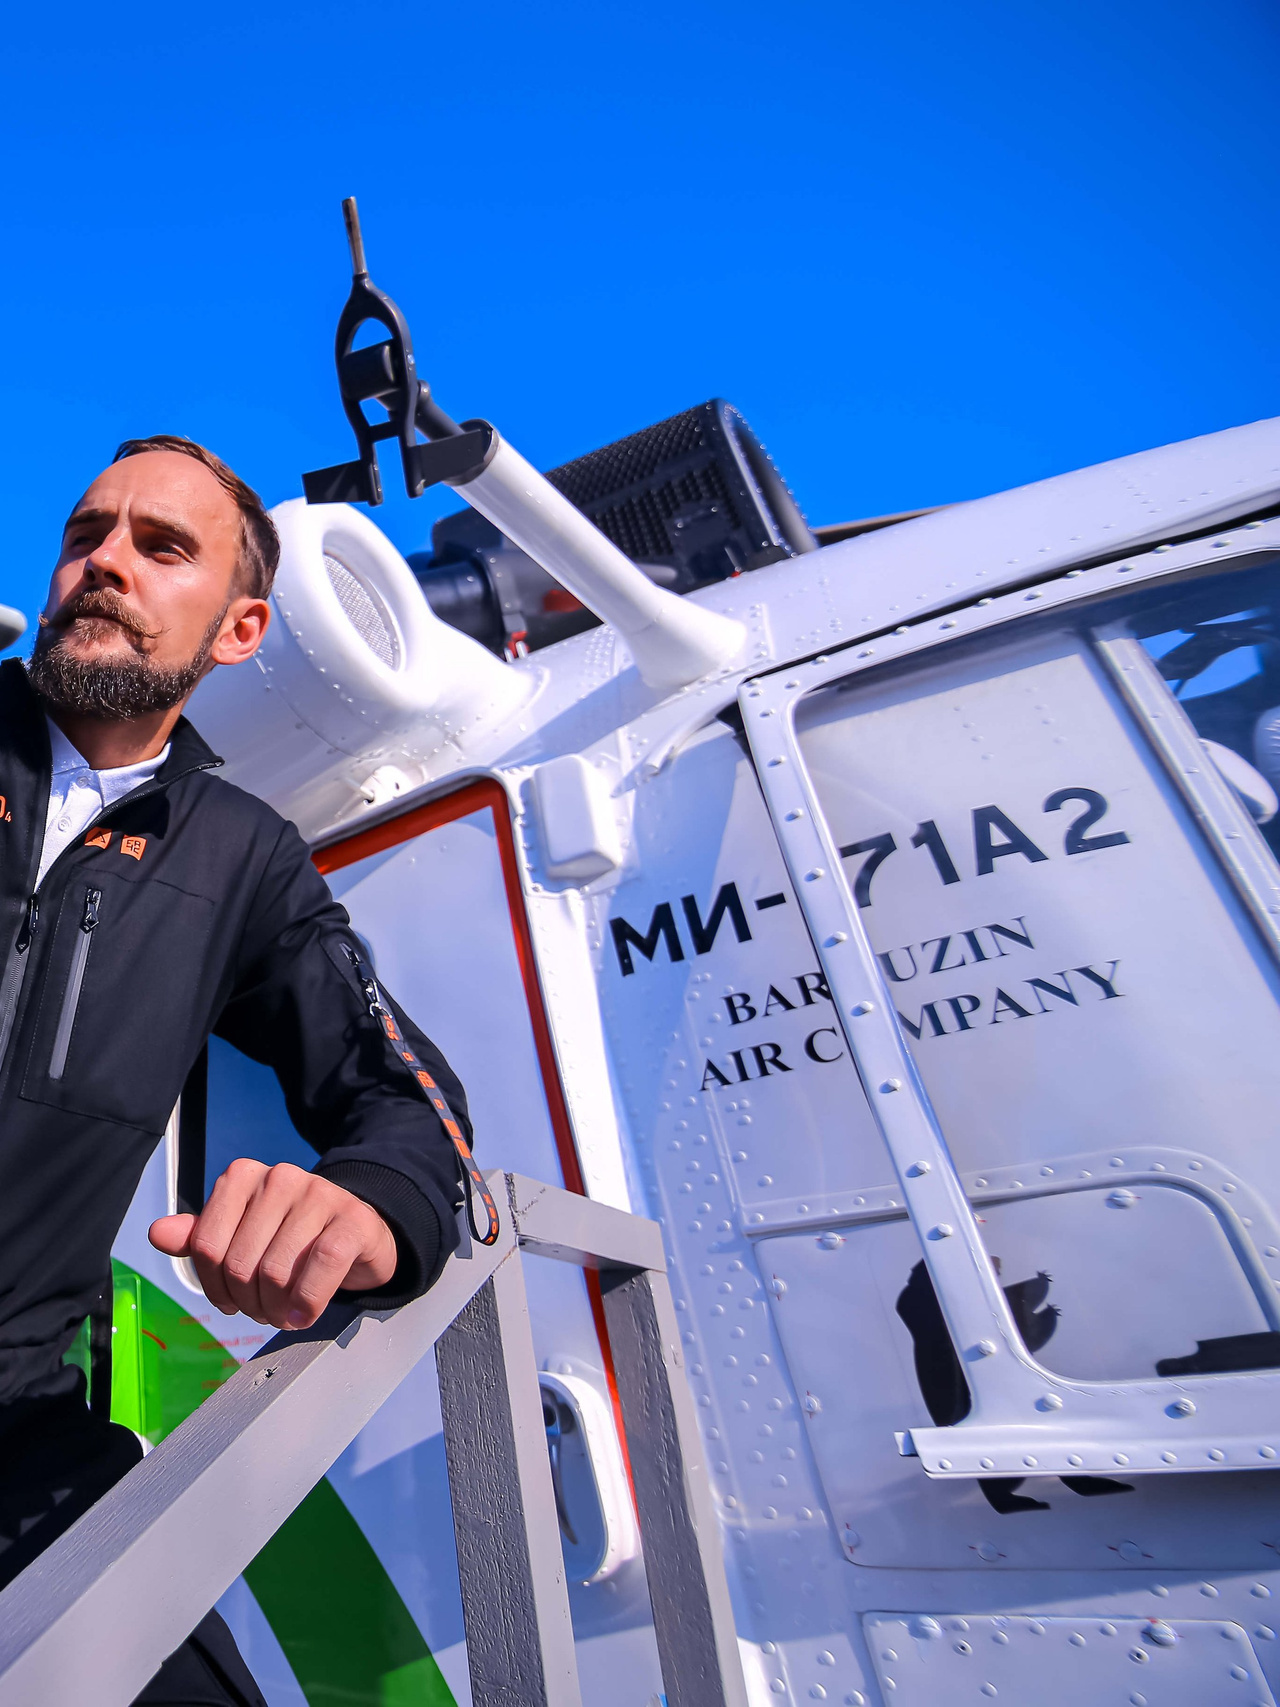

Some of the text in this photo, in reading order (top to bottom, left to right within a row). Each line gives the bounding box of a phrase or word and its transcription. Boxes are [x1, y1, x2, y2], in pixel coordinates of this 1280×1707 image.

[699, 959, 1126, 1091] AIR CMPANY
[721, 915, 1035, 1026] BARUZIN
